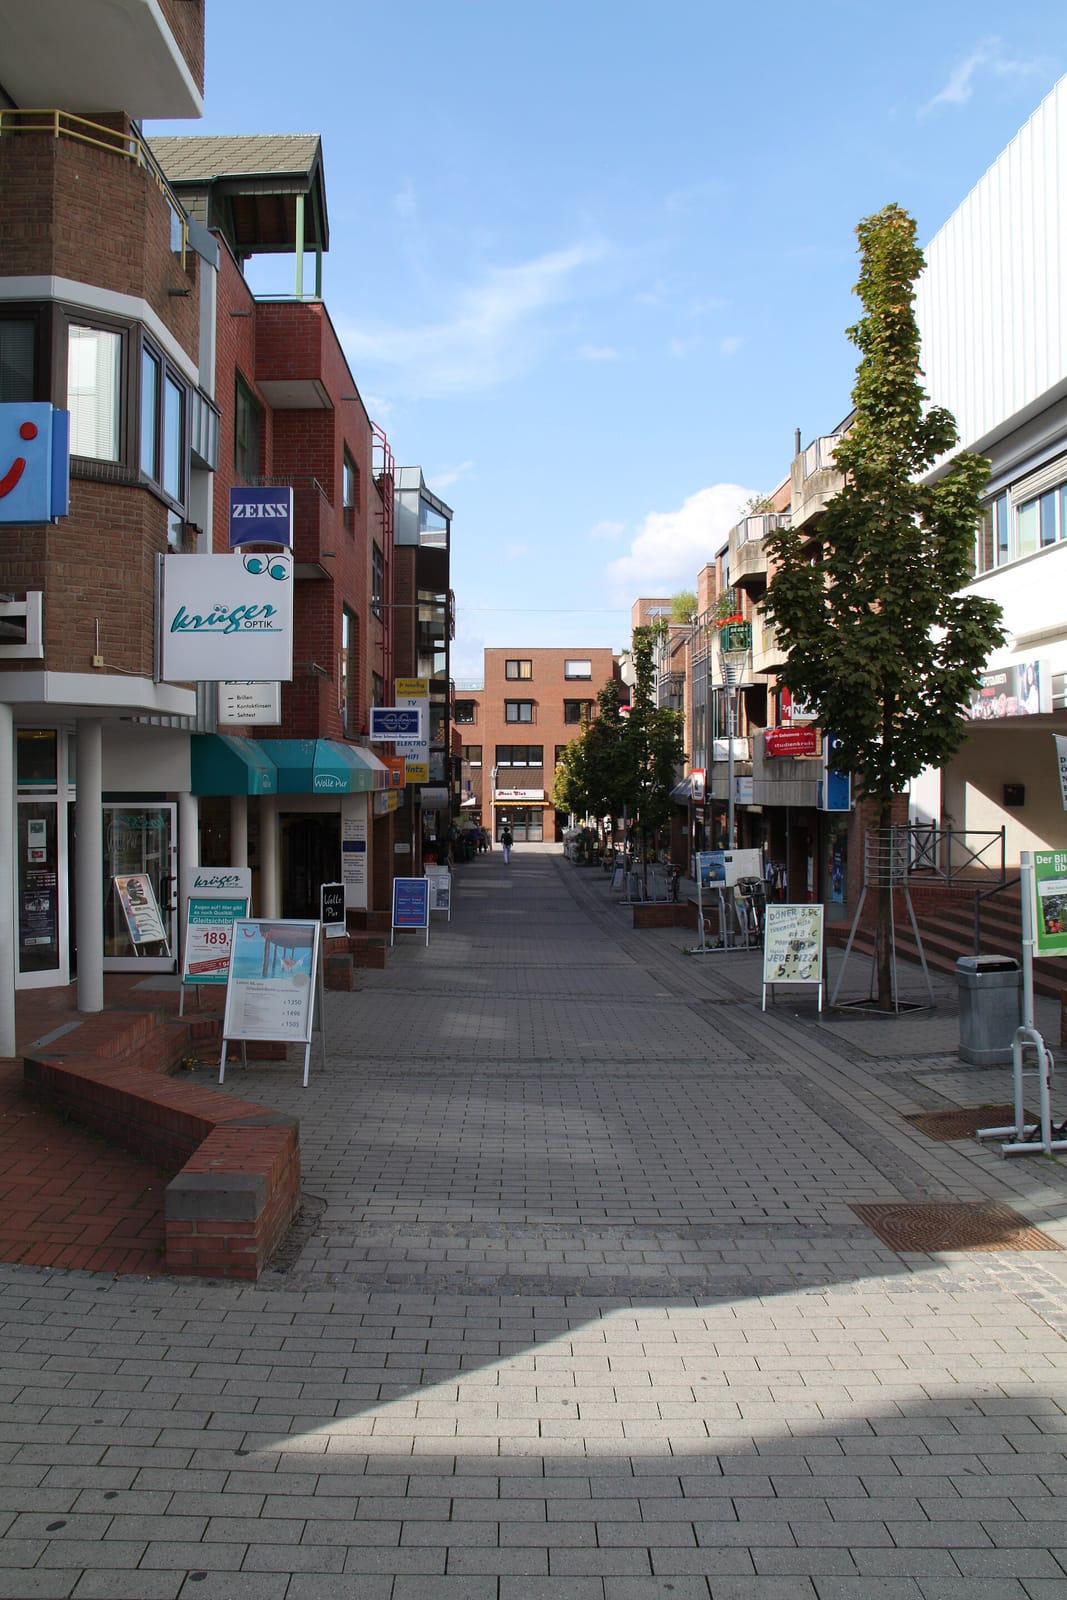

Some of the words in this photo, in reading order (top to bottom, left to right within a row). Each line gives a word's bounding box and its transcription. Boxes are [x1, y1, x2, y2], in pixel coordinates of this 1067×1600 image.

[232, 503, 288, 519] ZEISS
[171, 604, 278, 634] krüger
[244, 620, 273, 629] OPTIK
[315, 777, 334, 787] Wolle
[1036, 855, 1053, 864] Der
[194, 875, 240, 888] krüger
[769, 908, 797, 920] DÖNER
[768, 953, 791, 962] JEDE
[793, 953, 818, 962] PIZZA
